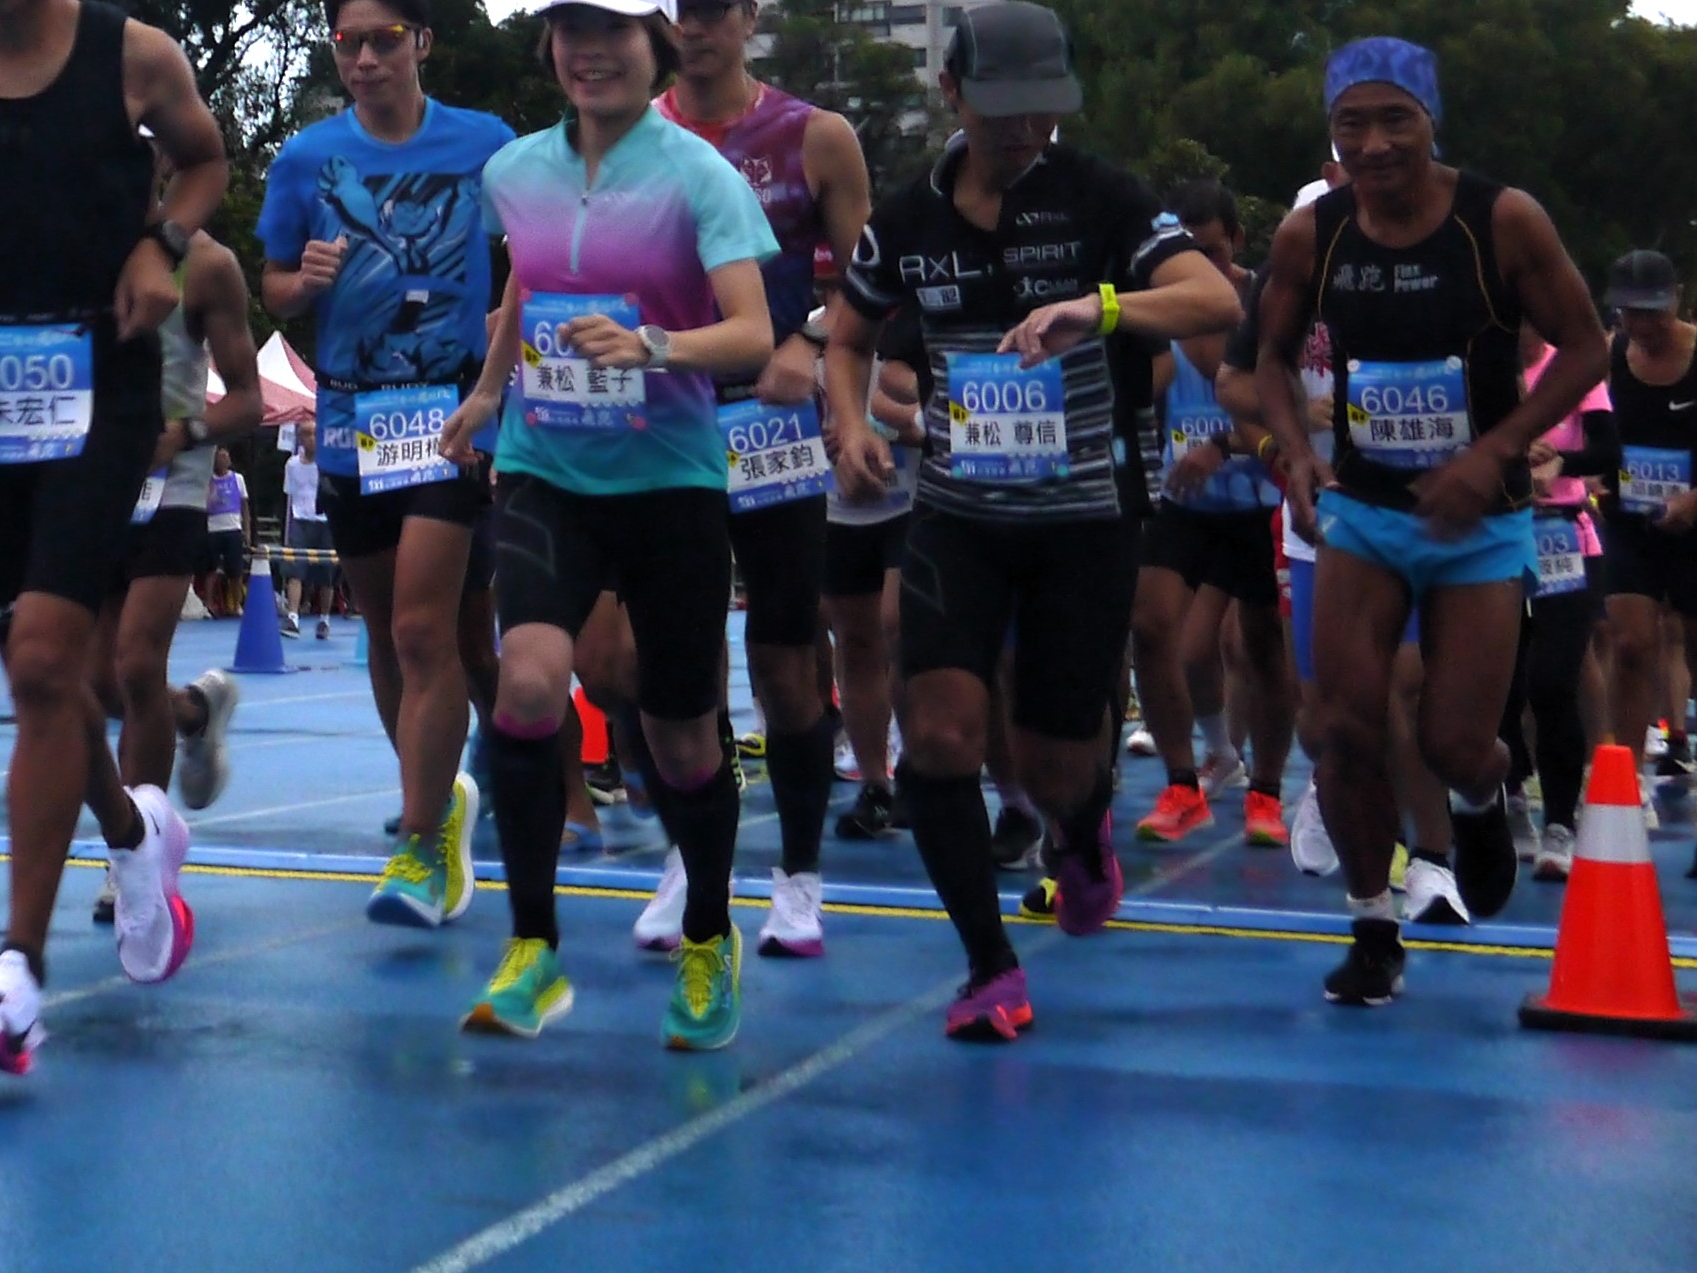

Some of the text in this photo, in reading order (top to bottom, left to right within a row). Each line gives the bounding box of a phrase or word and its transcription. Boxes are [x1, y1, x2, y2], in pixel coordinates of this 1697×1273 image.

[1003, 241, 1081, 263] SPIRIT
[1394, 276, 1438, 293] Power
[963, 380, 1046, 412] 6006
[1361, 385, 1448, 414] 6046
[369, 408, 445, 440] 6048
[729, 412, 803, 453] 6021
[966, 420, 1002, 446] 兼松
[1370, 417, 1454, 442] 陳雄海
[1627, 460, 1680, 481] 6013
